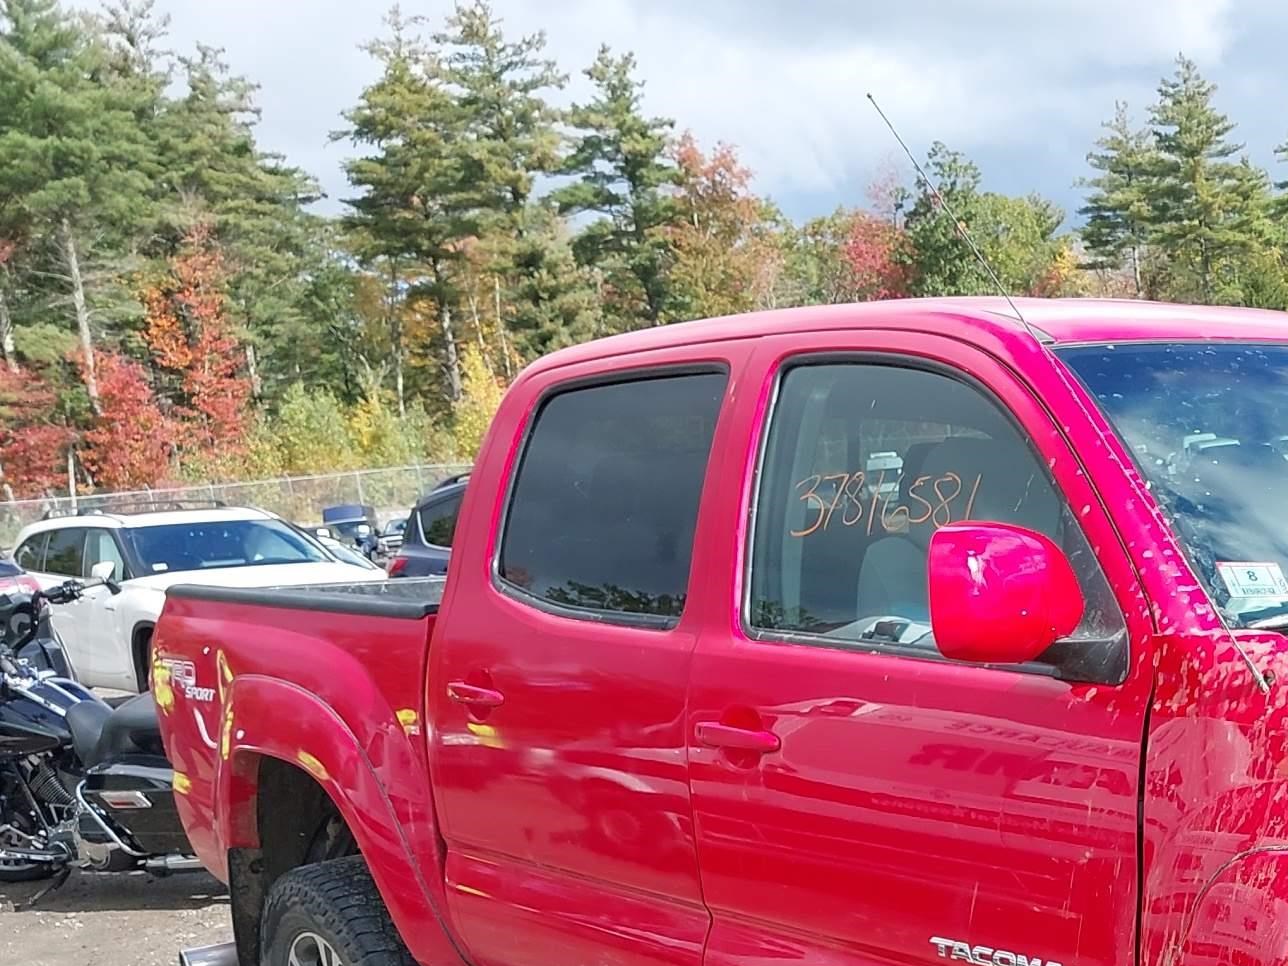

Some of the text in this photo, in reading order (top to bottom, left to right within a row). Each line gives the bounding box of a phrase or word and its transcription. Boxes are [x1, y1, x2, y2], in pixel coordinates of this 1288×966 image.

[790, 471, 982, 537] 37816581
[1247, 571, 1258, 581] 8
[185, 687, 216, 702] SPORT
